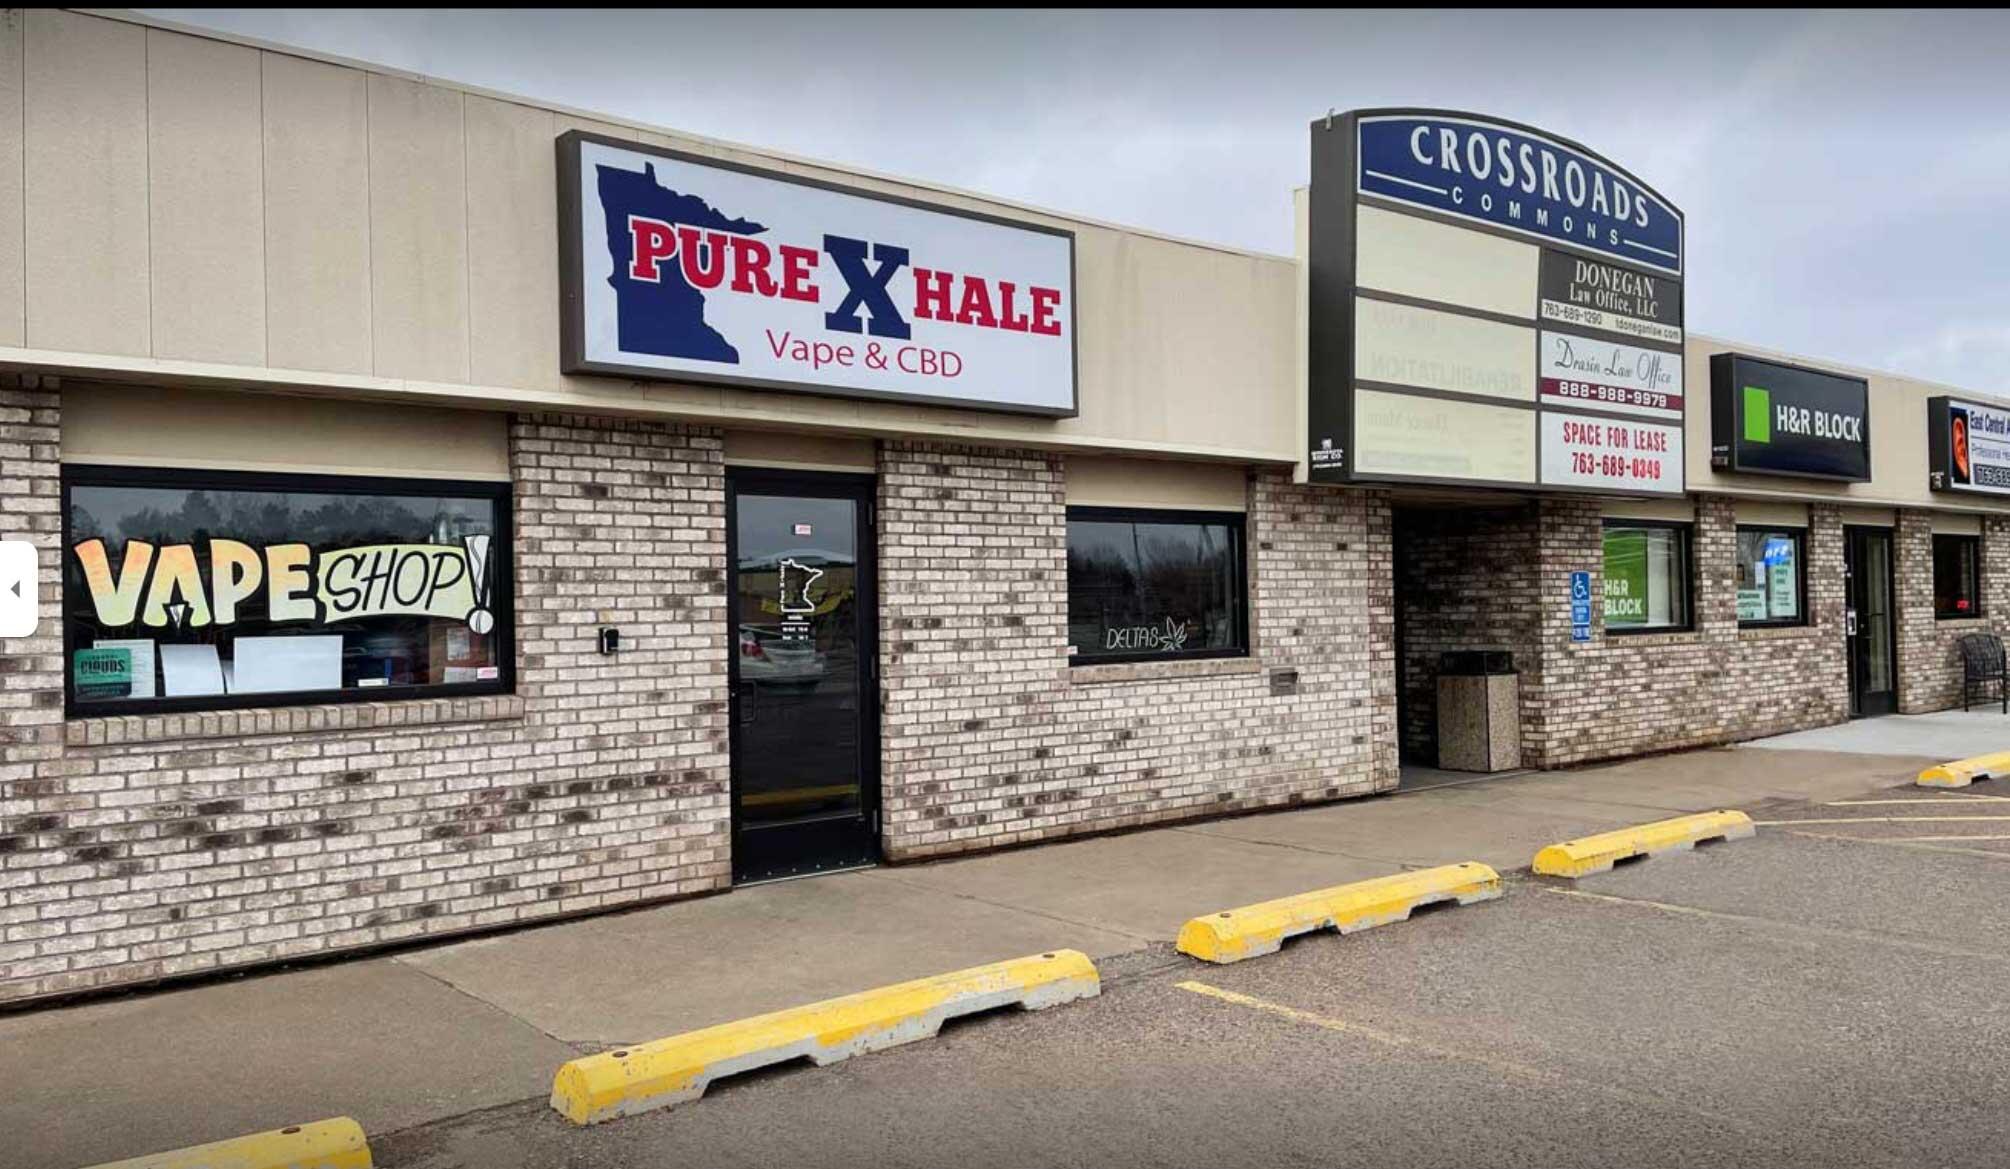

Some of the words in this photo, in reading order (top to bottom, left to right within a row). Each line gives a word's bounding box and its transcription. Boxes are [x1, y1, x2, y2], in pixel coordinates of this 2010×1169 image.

[1410, 125, 1649, 228] CROSSROADS
[1452, 186, 1619, 246] COMMONS
[628, 214, 820, 303] PURE
[913, 267, 1062, 336] HALE
[1576, 260, 1656, 299] DONEGAN
[1570, 283, 1590, 304] Law
[1596, 289, 1633, 314] Office,
[1637, 298, 1659, 318] LLC
[766, 329, 855, 370] Vape
[865, 344, 887, 370] &
[897, 345, 963, 378] CBD
[1555, 338, 1600, 374] Drasin
[1604, 348, 1633, 377] Law
[1637, 352, 1673, 390] Office
[1559, 381, 1667, 407] 888-988-9979
[1563, 421, 1602, 446] SPACE
[1607, 426, 1629, 448] FOR
[1634, 429, 1667, 452] LEASE
[1776, 404, 1811, 432] H&R
[1815, 410, 1861, 442] BLOCK
[1970, 410, 1983, 431] East
[1985, 413, 2005, 434] Central
[1572, 451, 1661, 480] 763-689-0349
[73, 538, 312, 628] VAPE
[1604, 579, 1629, 596] H&R
[1604, 598, 1643, 616] BLOCK
